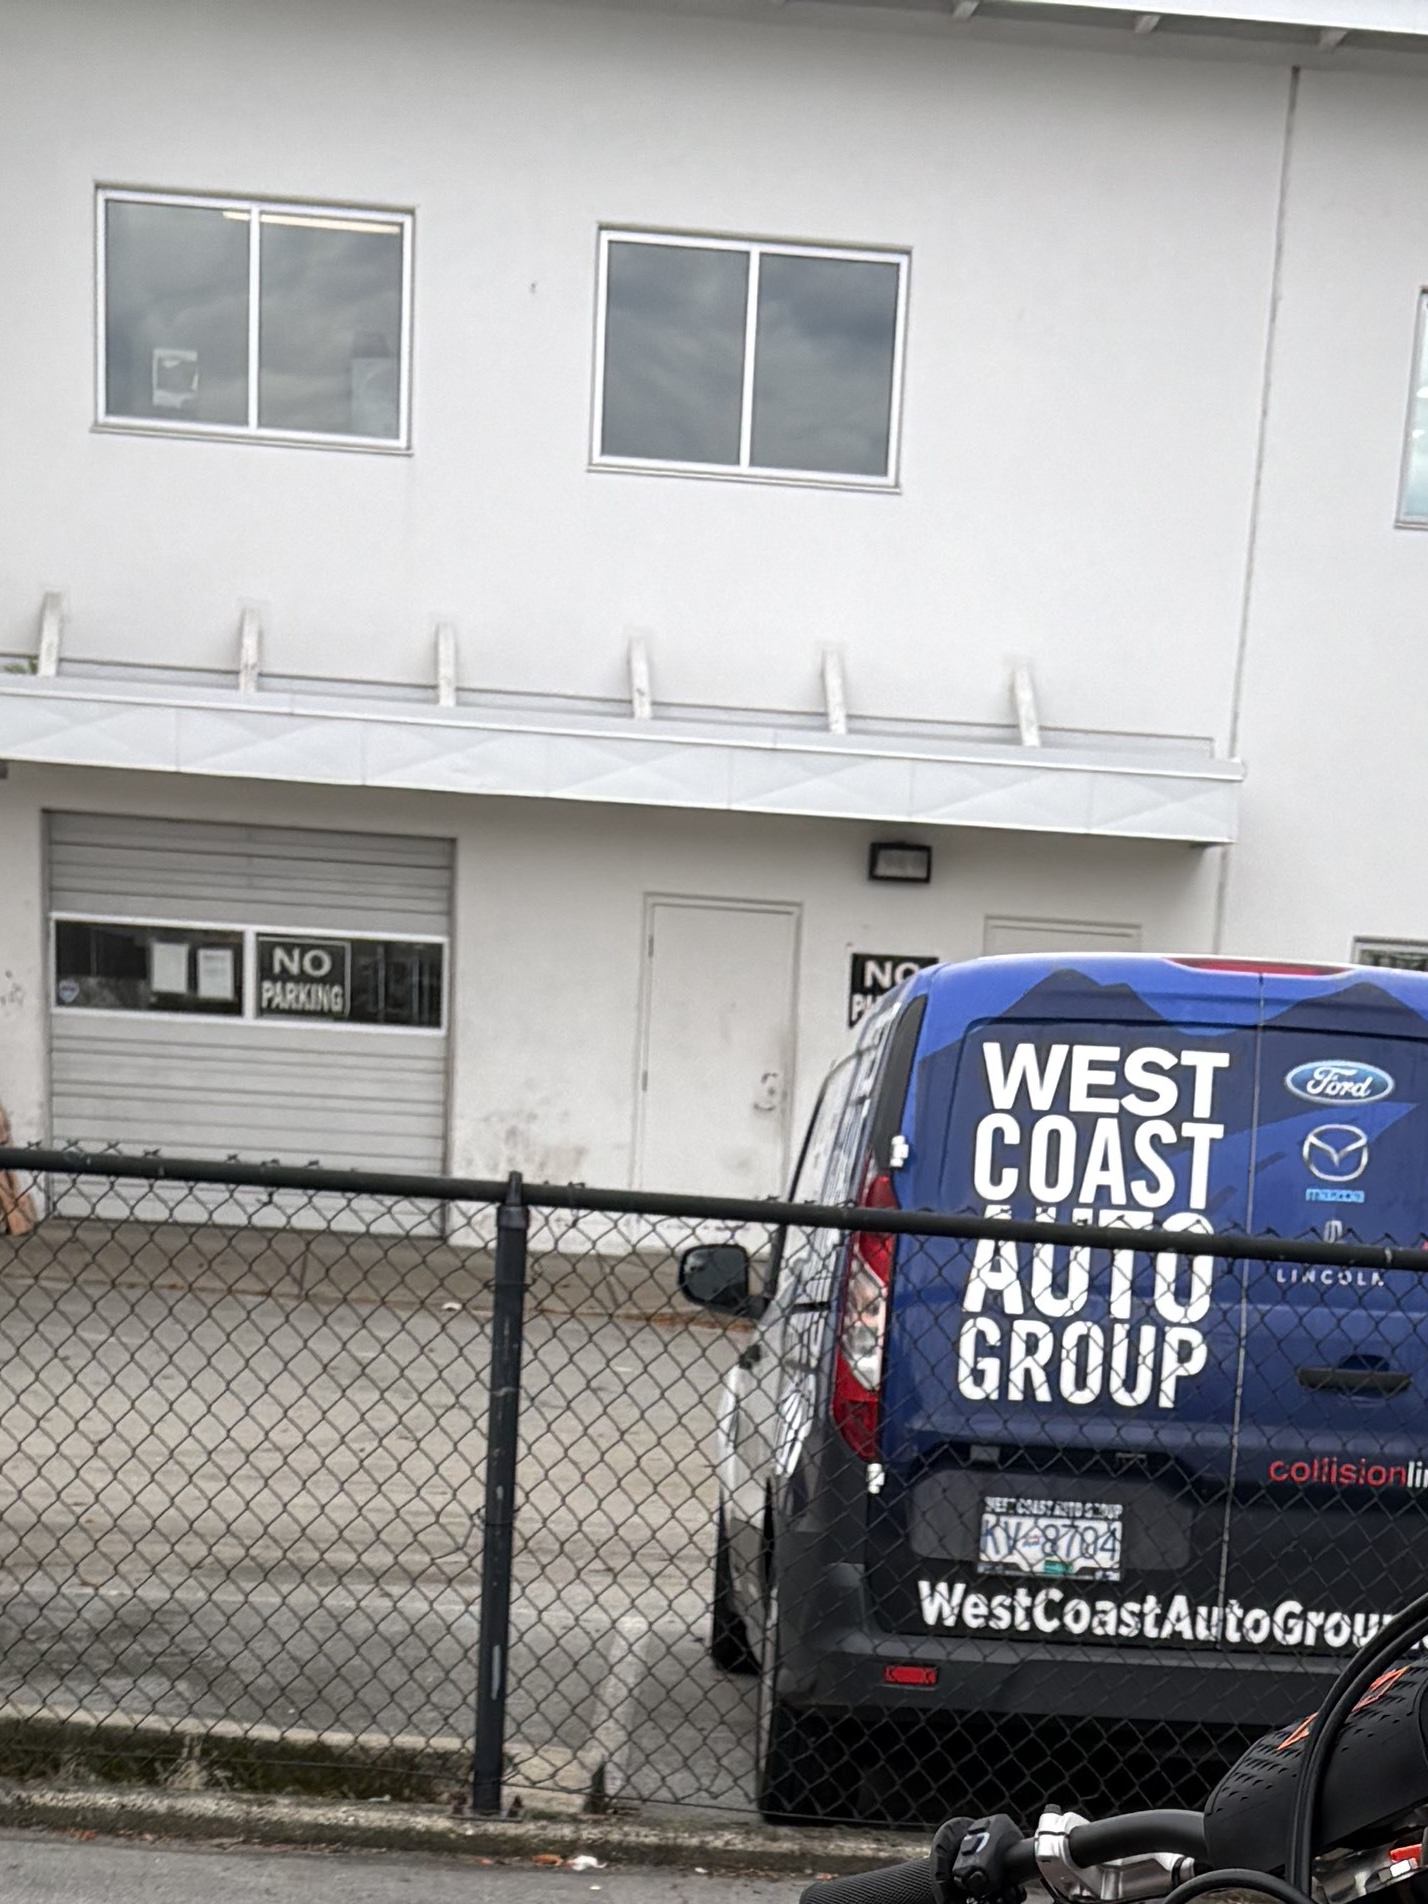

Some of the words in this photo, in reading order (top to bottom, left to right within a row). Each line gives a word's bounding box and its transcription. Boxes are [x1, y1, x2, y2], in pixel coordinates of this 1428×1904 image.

[273, 947, 332, 977] NO
[261, 980, 344, 1013] PARKING
[983, 1042, 1230, 1118] WEST
[1306, 1065, 1374, 1098] Ford
[974, 1113, 1224, 1210] COAST
[962, 1204, 1215, 1324] AUTO
[958, 1316, 1209, 1408] GROUP
[1084, 1503, 1123, 1519] GOUP
